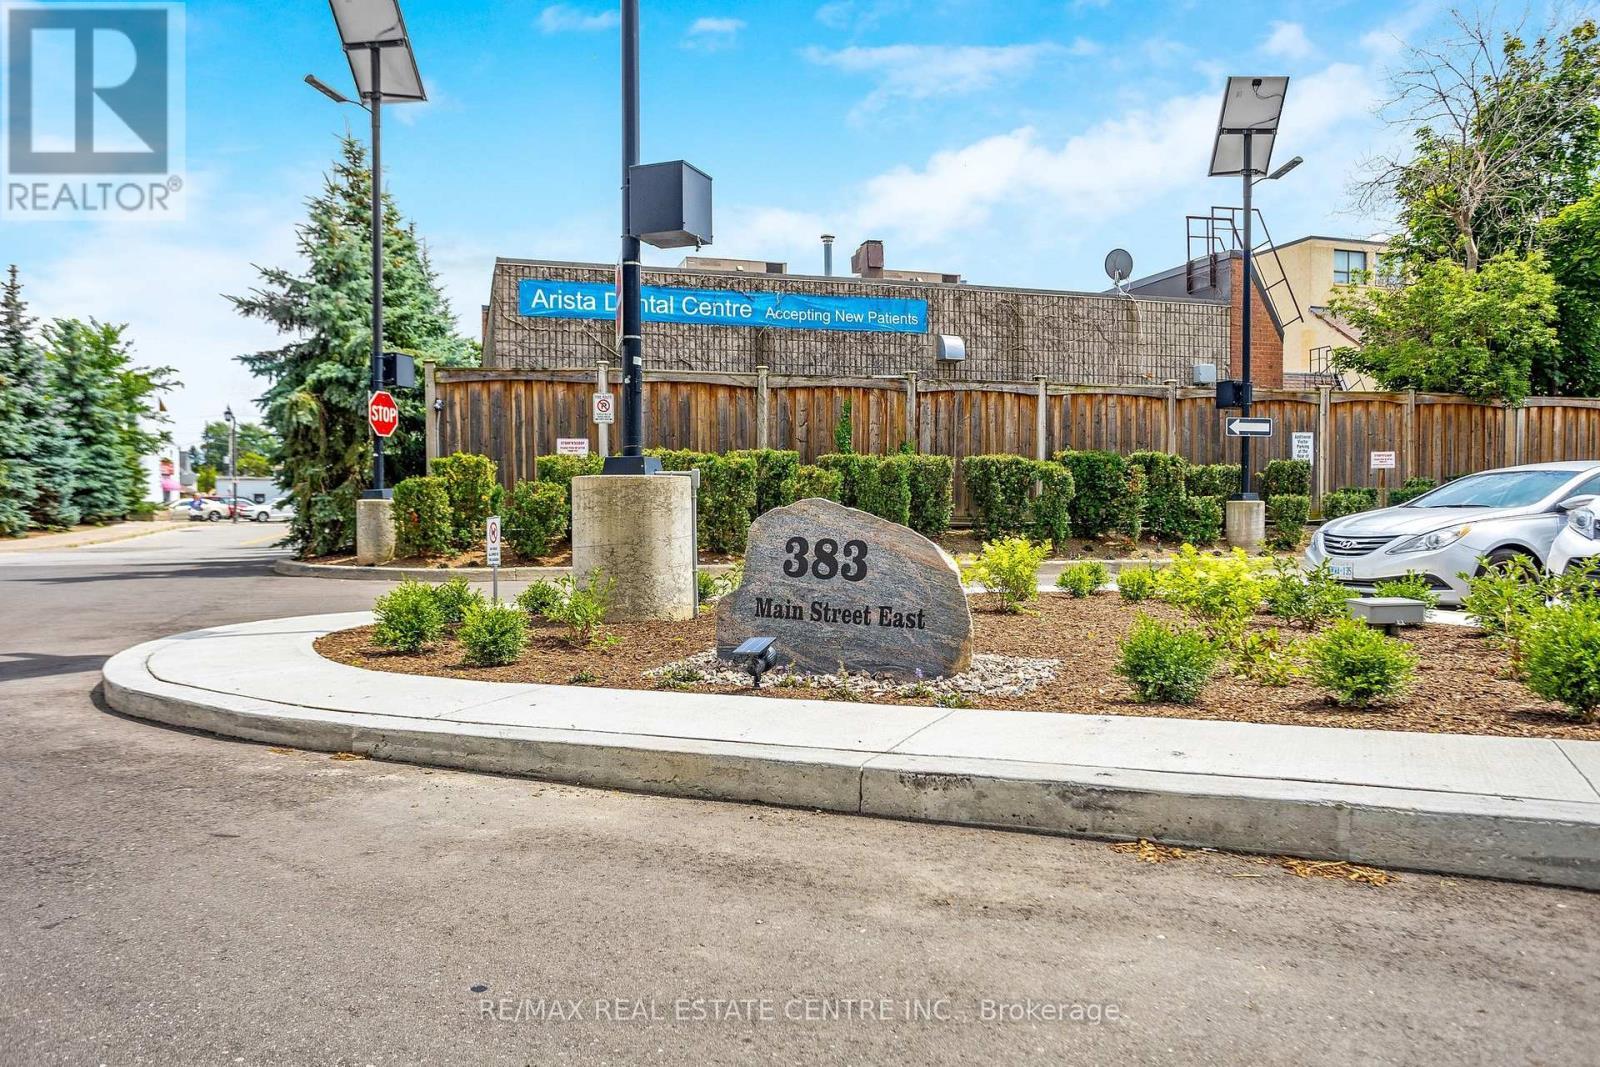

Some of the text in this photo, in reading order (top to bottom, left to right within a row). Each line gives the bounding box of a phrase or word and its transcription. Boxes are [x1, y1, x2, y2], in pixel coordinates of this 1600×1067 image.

[531, 289, 919, 326] Arista Dntal Centre Accepting New Patients
[371, 404, 396, 423] STOP
[783, 536, 868, 582] 383
[754, 597, 926, 630] Main Street East
